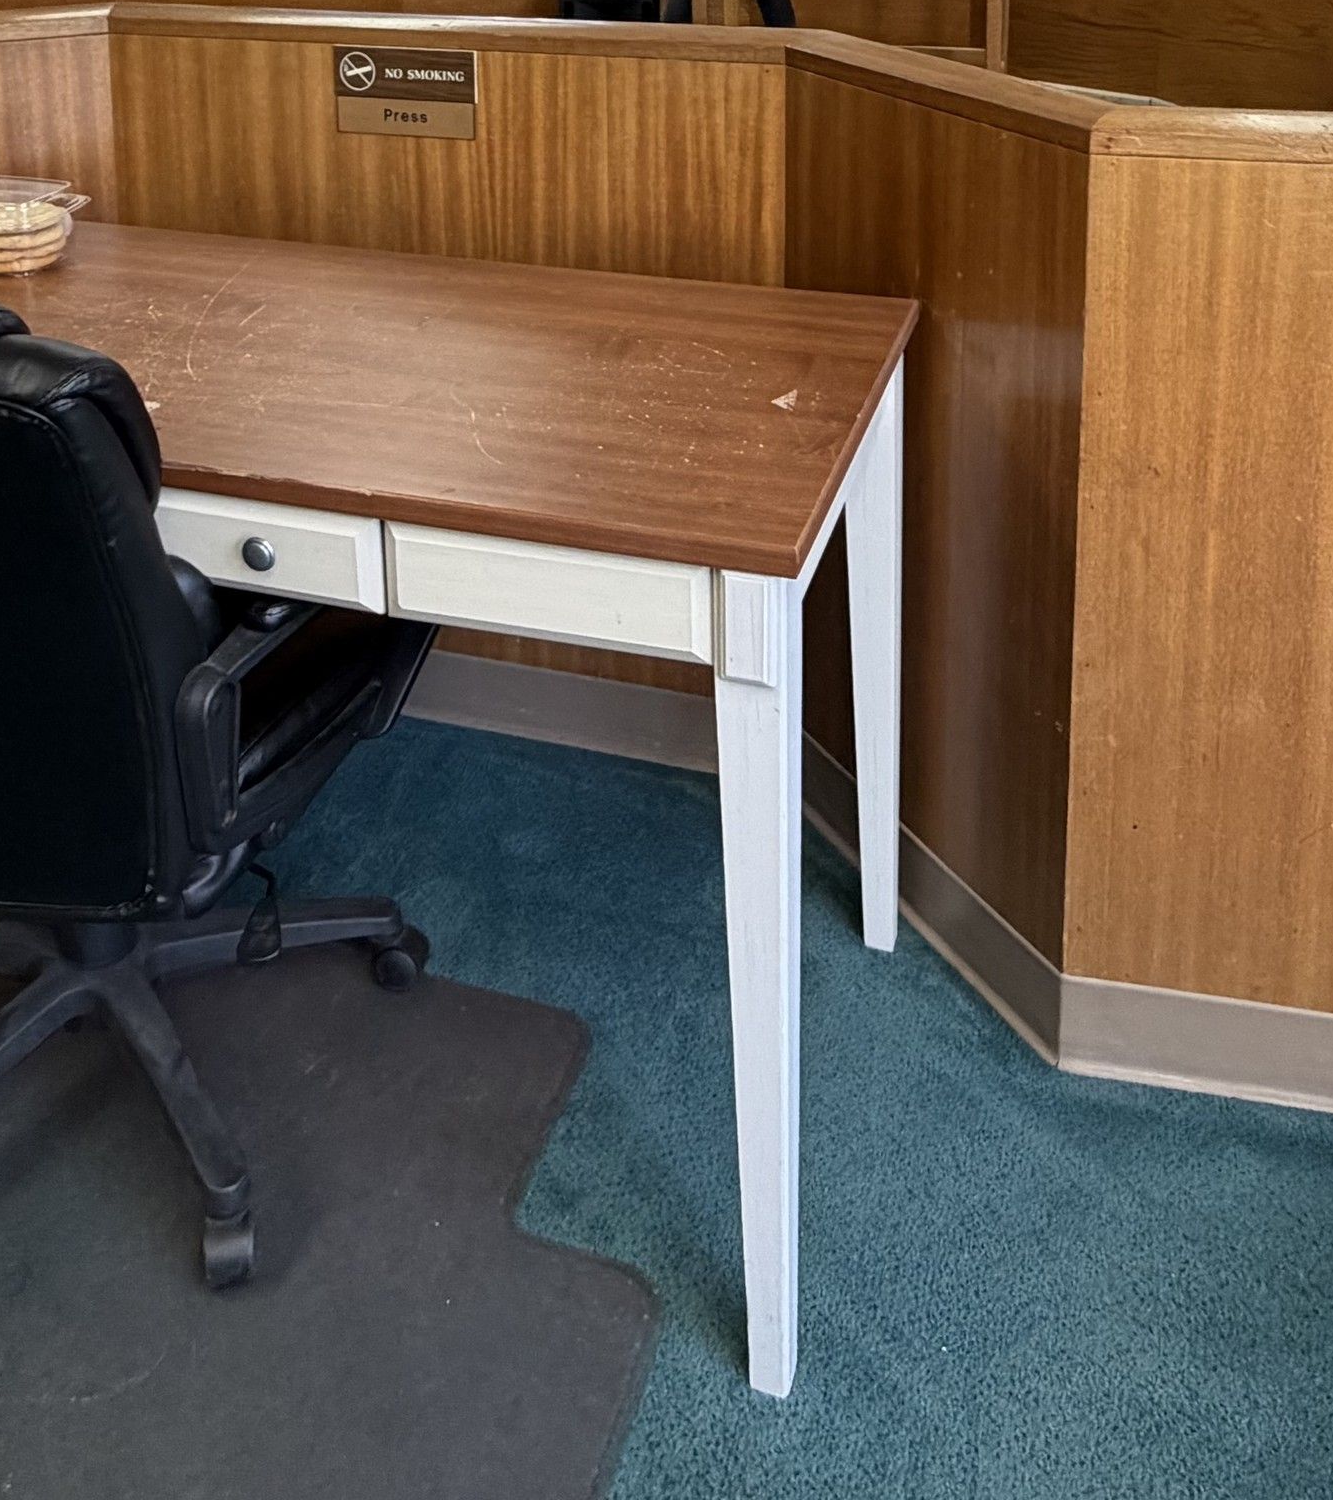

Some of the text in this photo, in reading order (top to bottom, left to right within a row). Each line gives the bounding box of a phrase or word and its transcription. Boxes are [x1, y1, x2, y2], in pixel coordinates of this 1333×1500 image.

[384, 68, 465, 82] NO SMOKING
[383, 108, 428, 123] Press
